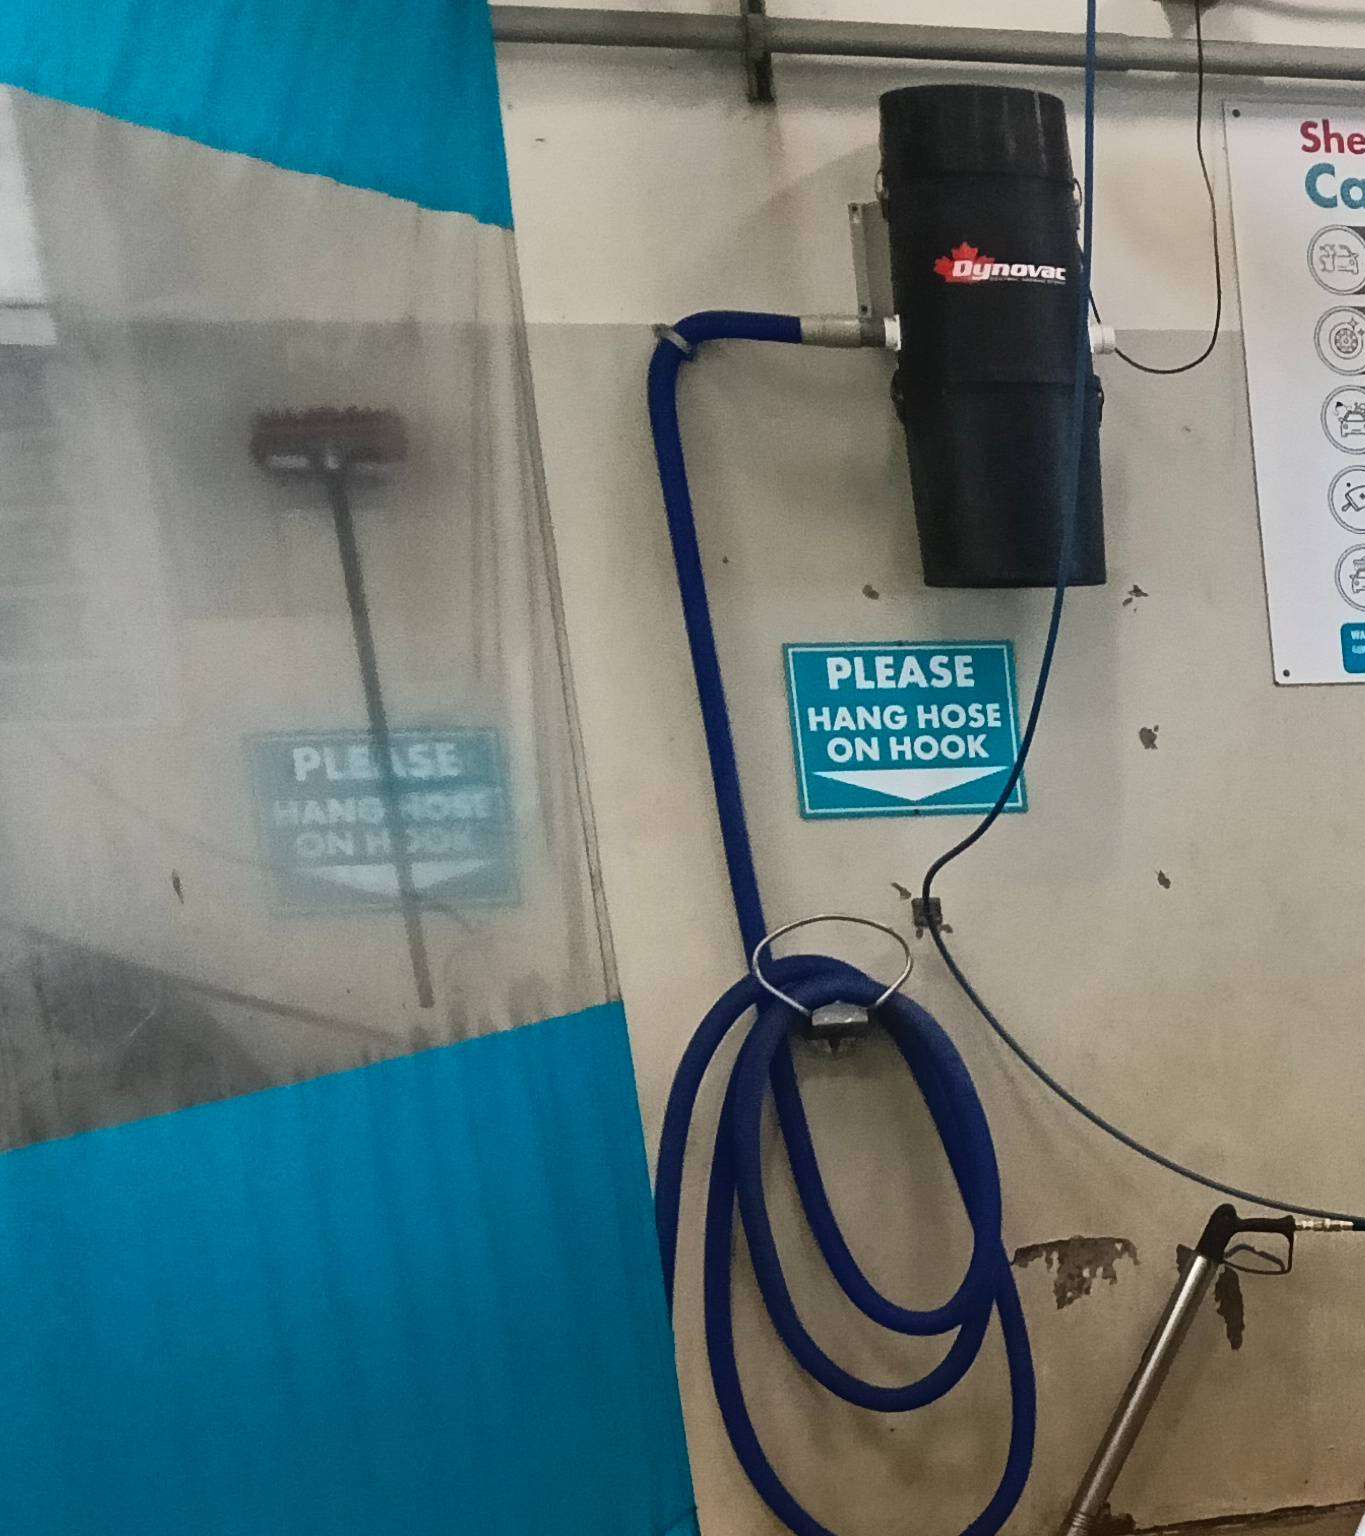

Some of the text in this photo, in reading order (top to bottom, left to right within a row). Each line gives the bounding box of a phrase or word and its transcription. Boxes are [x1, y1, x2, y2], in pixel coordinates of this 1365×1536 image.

[952, 260, 1065, 282] Dynovac
[827, 656, 973, 688] PLEASE
[808, 704, 1001, 730] HANG HOSE
[827, 735, 988, 762] ON HOOK
